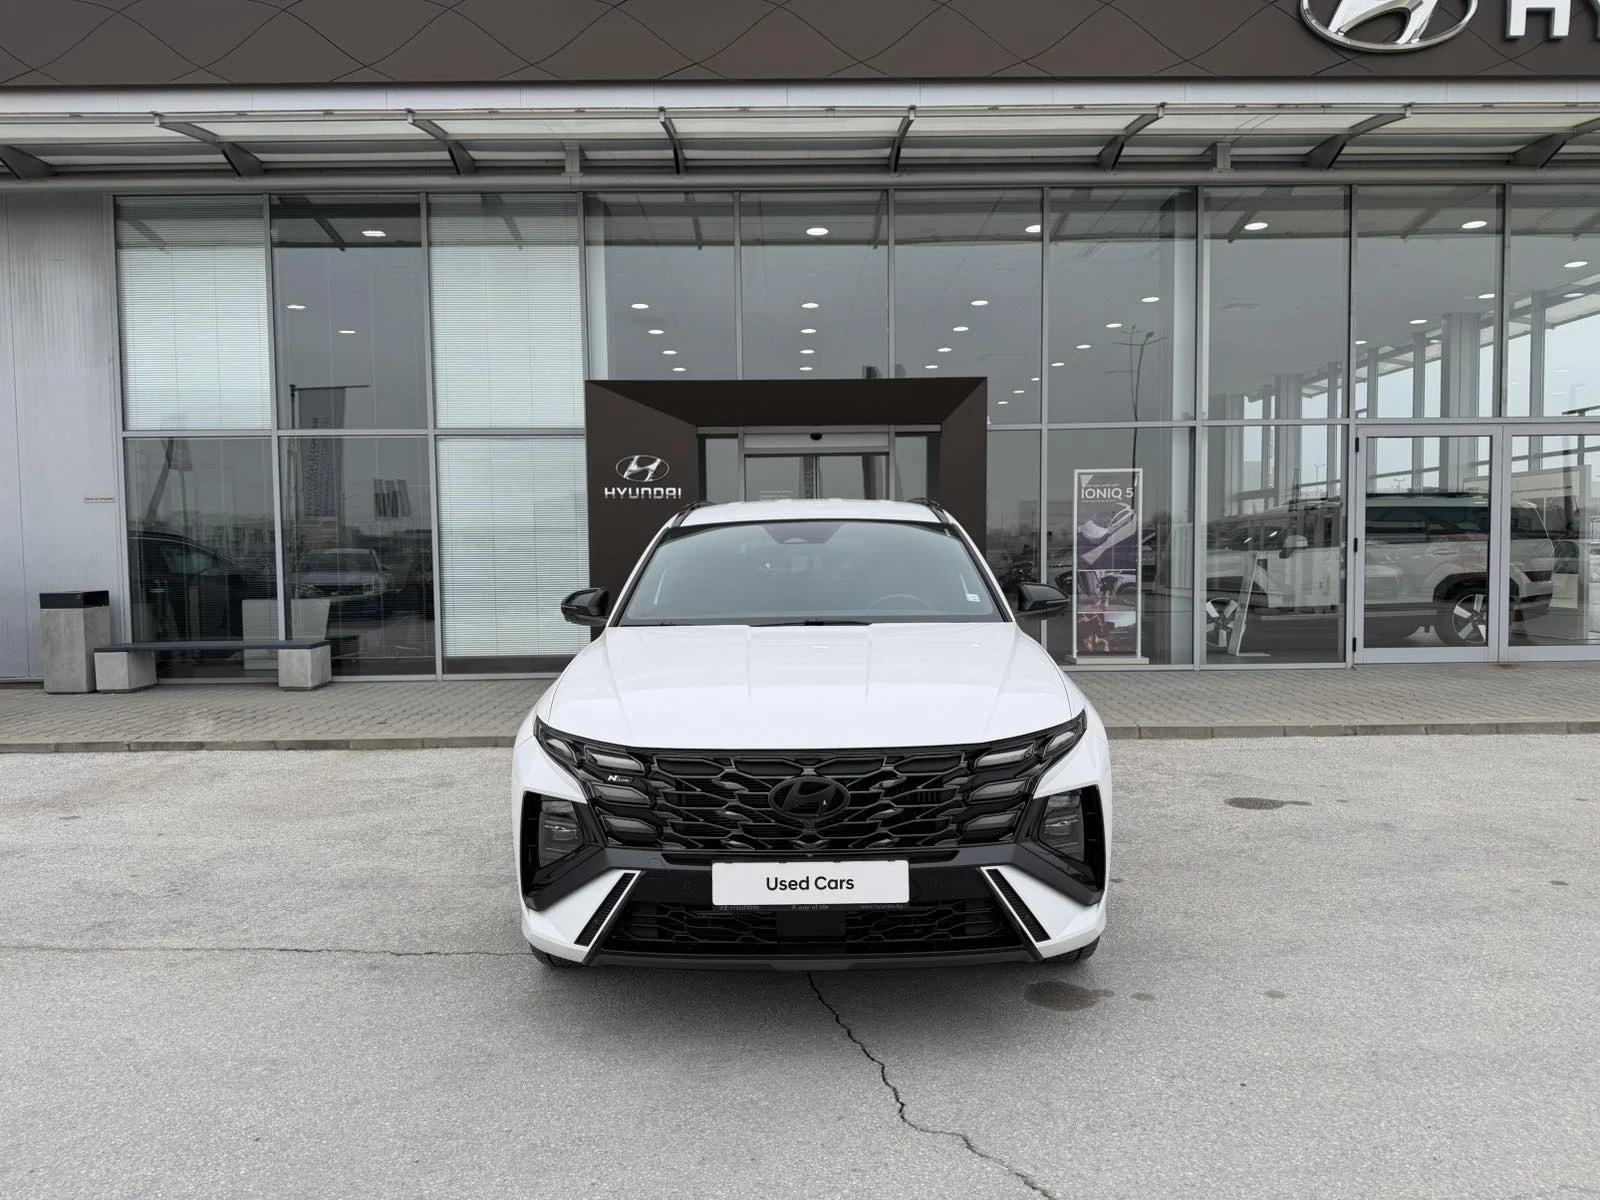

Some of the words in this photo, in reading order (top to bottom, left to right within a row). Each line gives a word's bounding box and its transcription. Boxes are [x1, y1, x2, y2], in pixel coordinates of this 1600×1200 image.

[1506, 0, 1600, 38] H
[604, 487, 682, 499] HYUNDAI
[1081, 487, 1122, 500] IONIQ
[1125, 487, 1134, 498] 5
[766, 876, 810, 891] Used
[814, 876, 855, 890] Cars
